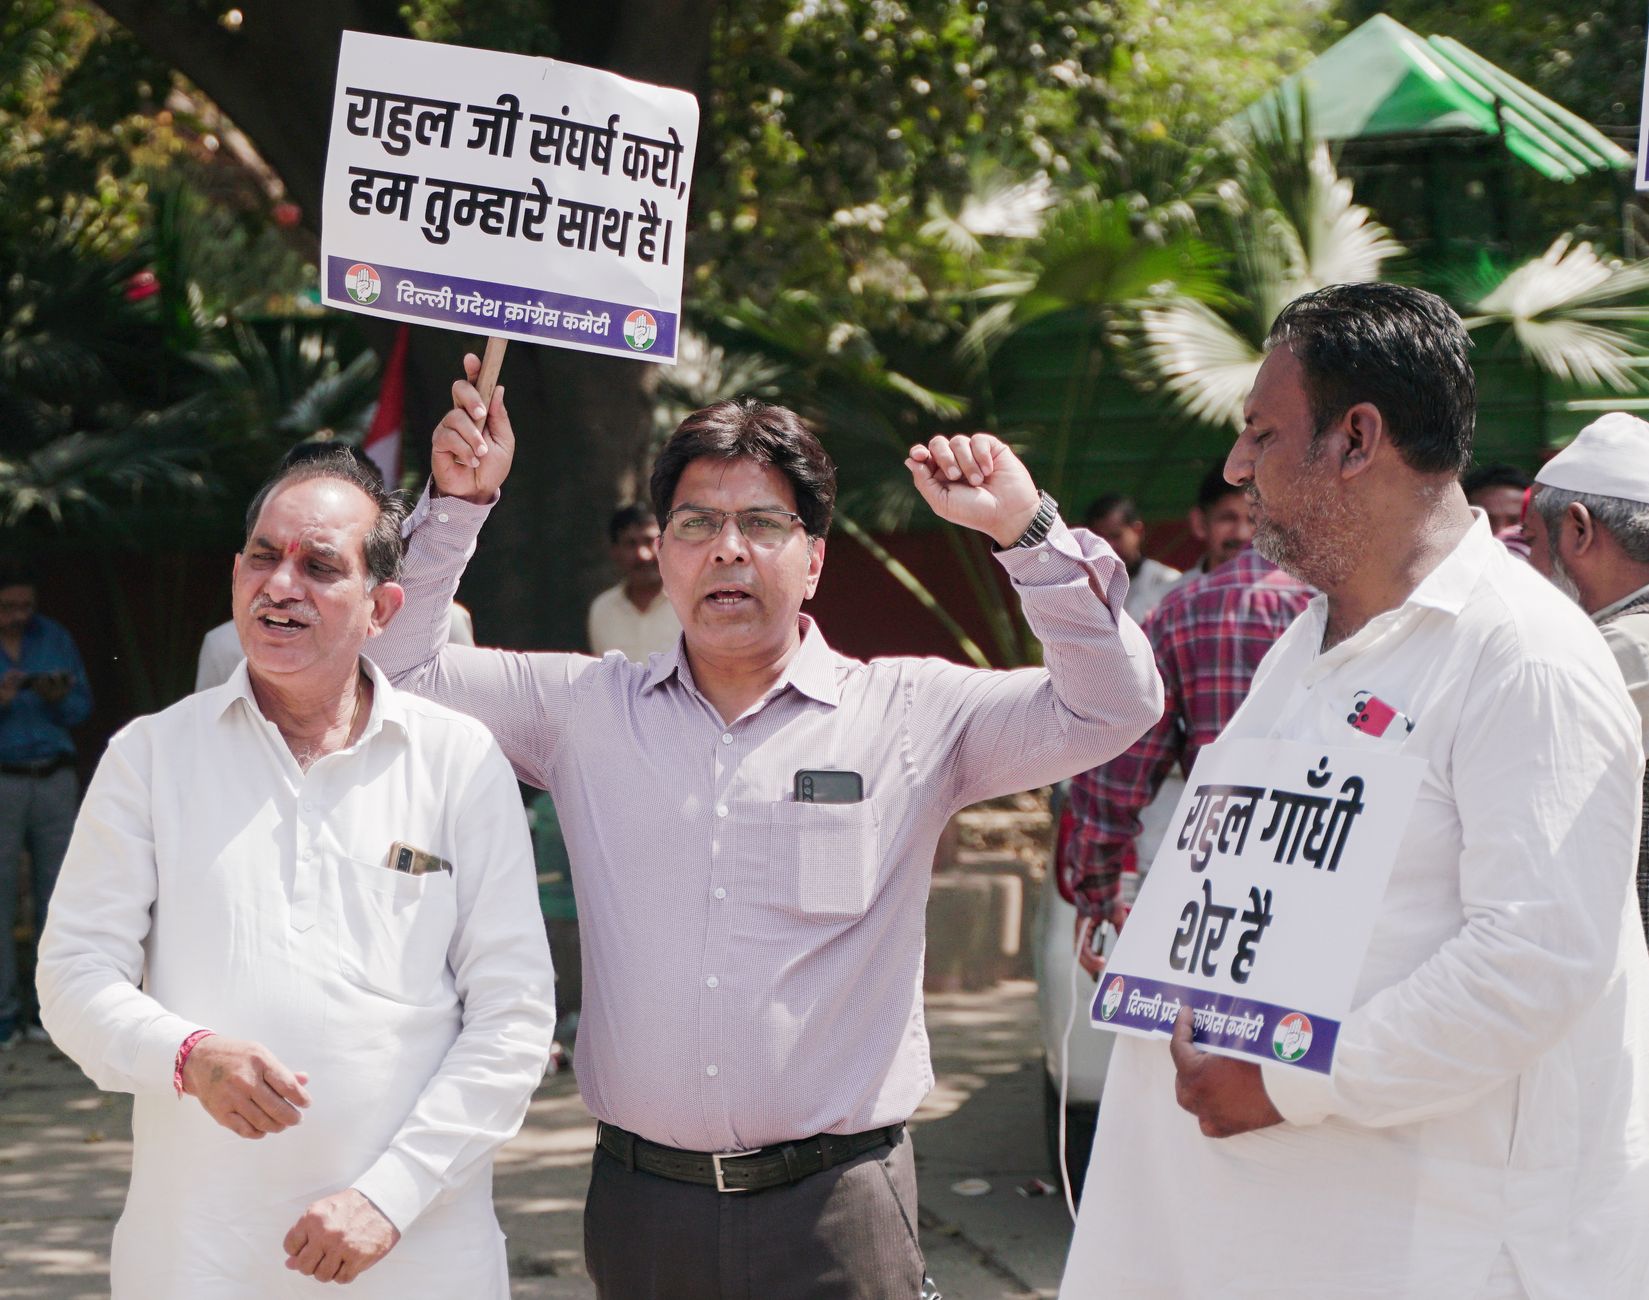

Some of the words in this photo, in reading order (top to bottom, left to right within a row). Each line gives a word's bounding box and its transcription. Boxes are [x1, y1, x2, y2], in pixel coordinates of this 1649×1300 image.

[345, 86, 461, 157] राहुल
[466, 93, 524, 158] जी
[529, 105, 621, 176] संघर्ष
[622, 126, 687, 201] करो,
[348, 165, 419, 222] हम
[421, 177, 553, 245] तुम्हारे
[556, 198, 634, 257] साथ
[396, 280, 453, 311] दिल्ली
[455, 291, 502, 319] प्रदेश
[504, 299, 561, 328] कांग्रेस
[562, 310, 611, 337] कमेटी
[1177, 784, 1267, 873] राहुल
[1260, 755, 1365, 872] गाँधी
[1169, 878, 1237, 978] शेर
[1230, 886, 1273, 984] है
[1126, 988, 1162, 1020] दिल्ली
[1159, 997, 1182, 1024] प्रदे
[1225, 1011, 1265, 1042] कमेटी
